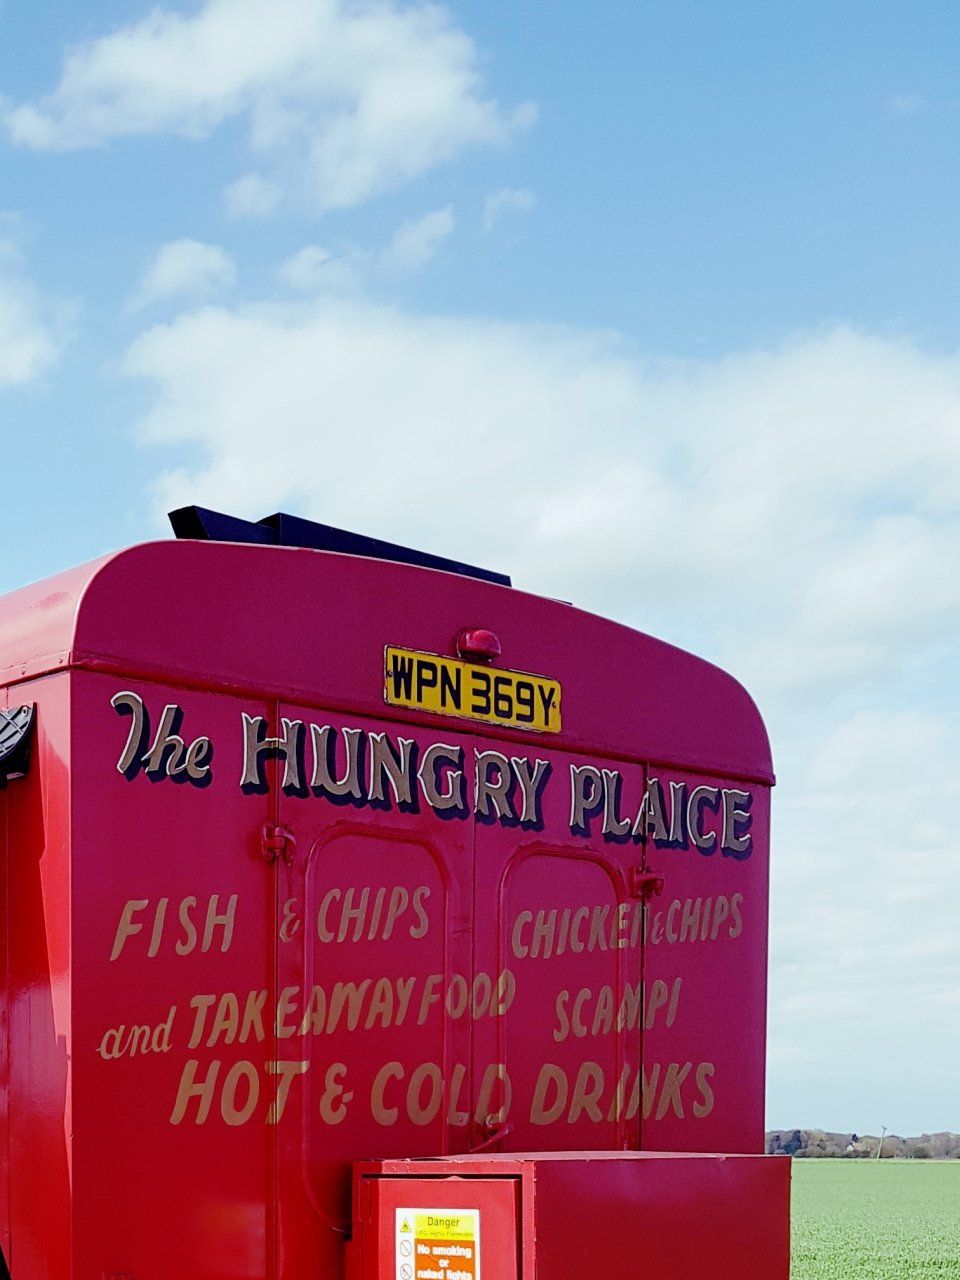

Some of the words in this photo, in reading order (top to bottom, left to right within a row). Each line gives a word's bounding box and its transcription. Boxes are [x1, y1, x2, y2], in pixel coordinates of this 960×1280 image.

[391, 653, 462, 707] WPN
[470, 668, 555, 727] 369Y
[110, 691, 212, 784] The
[240, 711, 551, 828] HUNGRY
[570, 764, 753, 857] PLAICE
[109, 894, 239, 962] FISH
[279, 897, 301, 943] &
[317, 885, 432, 943] CHIPS
[512, 901, 650, 960] CHICKEN
[651, 911, 665, 945] &
[665, 893, 744, 945] CHIPS
[96, 1006, 177, 1060] and
[553, 977, 681, 1042] SCAMPI
[169, 1059, 310, 1127] HOT
[320, 1062, 353, 1126] &
[371, 1062, 512, 1127] COLD
[530, 1061, 715, 1126] DRINKS
[417, 1244, 430, 1255] No
[432, 1245, 472, 1259] smoking
[427, 1216, 460, 1229] Danger
[417, 1269, 444, 1279] naked
[439, 1259, 449, 1268] or
